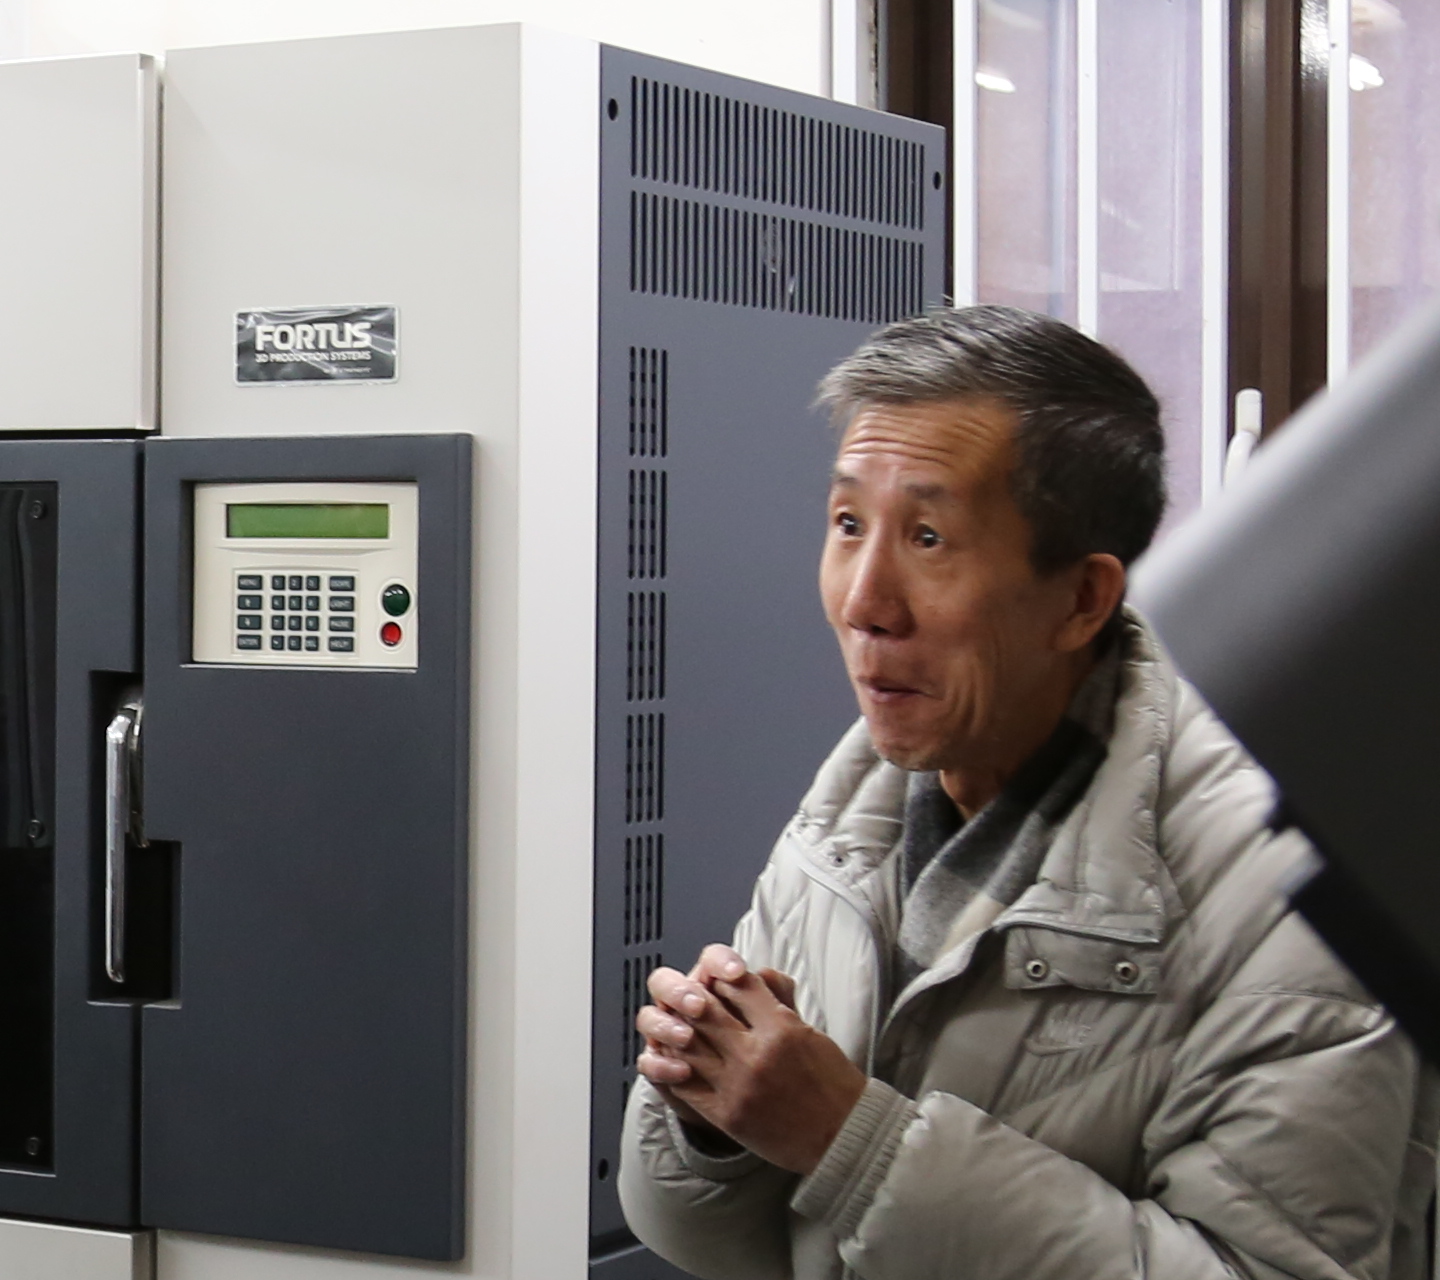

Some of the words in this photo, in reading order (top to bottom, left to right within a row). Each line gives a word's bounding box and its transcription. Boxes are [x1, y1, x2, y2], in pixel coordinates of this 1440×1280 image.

[255, 322, 372, 351] FORTUS
[255, 352, 269, 363] 3D
[331, 350, 372, 361] SYSTEMS
